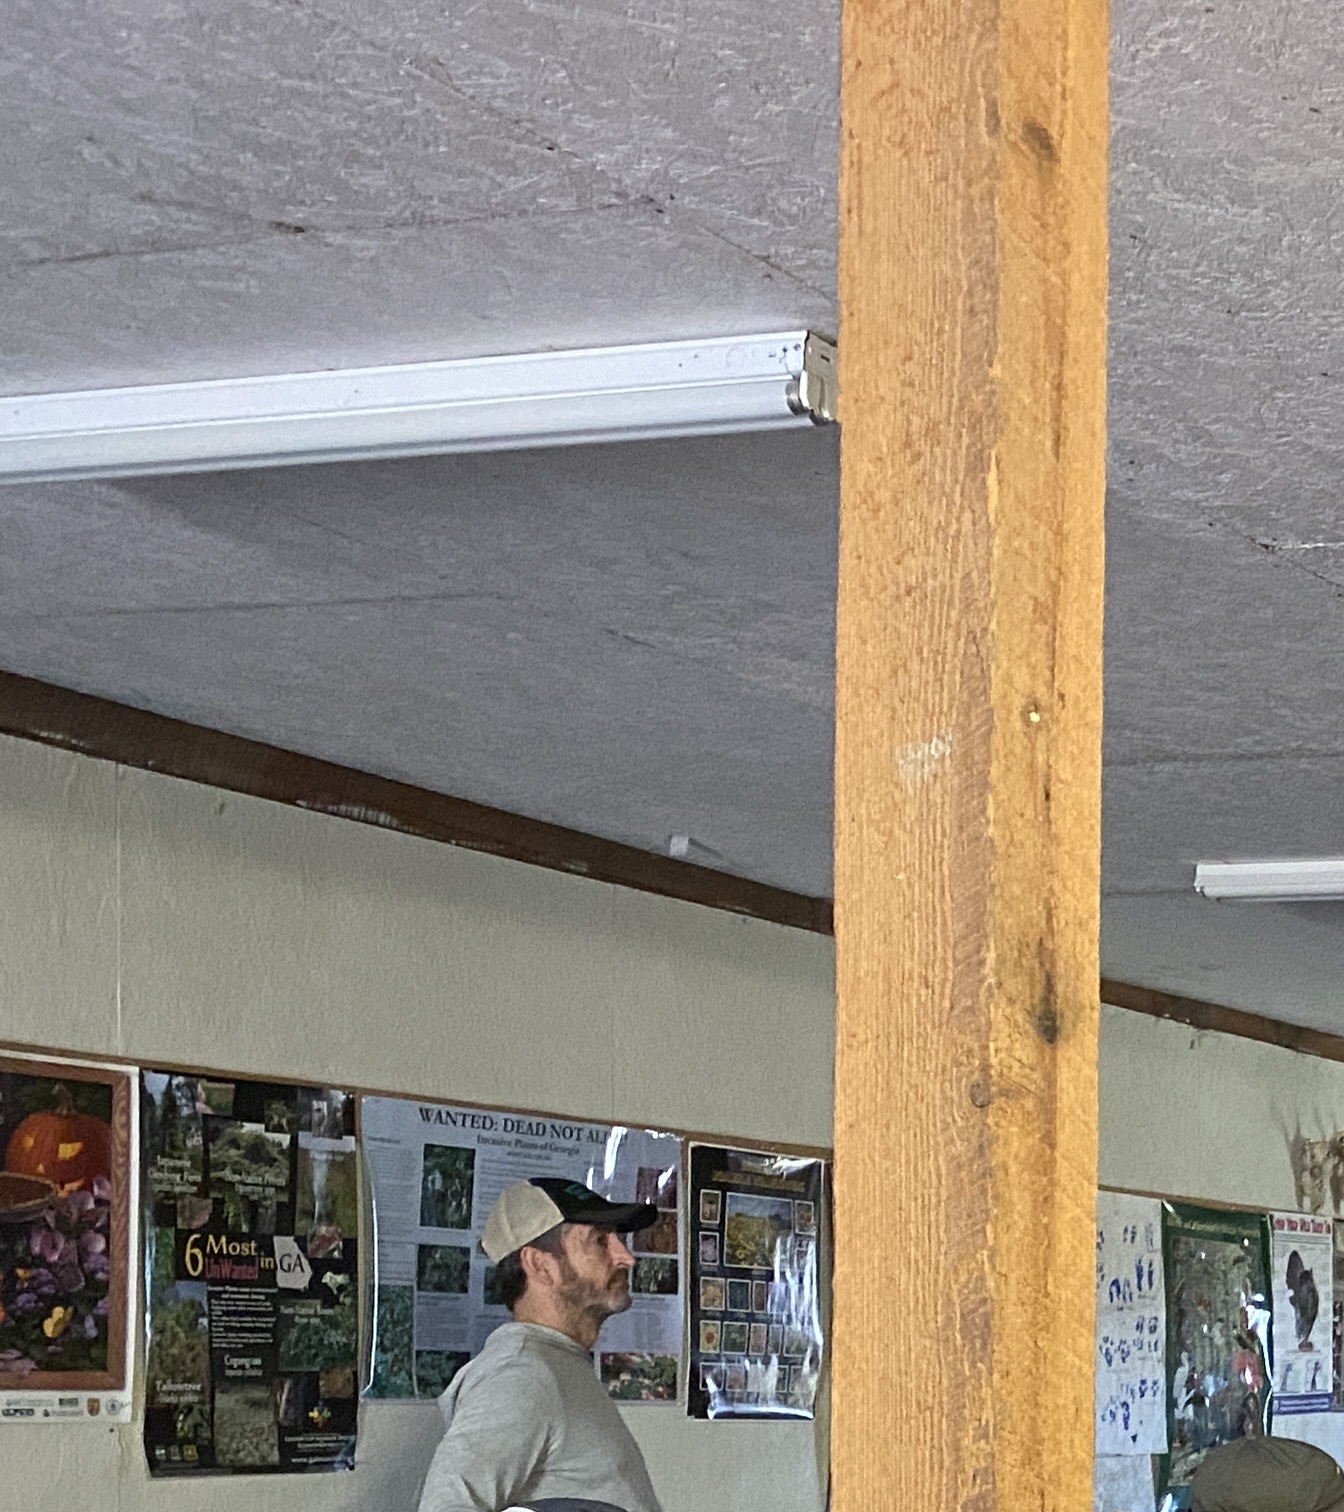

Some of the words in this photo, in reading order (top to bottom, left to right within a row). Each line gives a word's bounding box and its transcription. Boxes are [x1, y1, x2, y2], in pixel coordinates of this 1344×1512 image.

[418, 1107, 498, 1131] WANTED:
[502, 1118, 547, 1137] DEAD
[550, 1123, 583, 1142] NOT
[185, 1234, 204, 1277] 6
[206, 1234, 258, 1256] Most
[260, 1251, 275, 1269] in
[279, 1253, 305, 1274] GA
